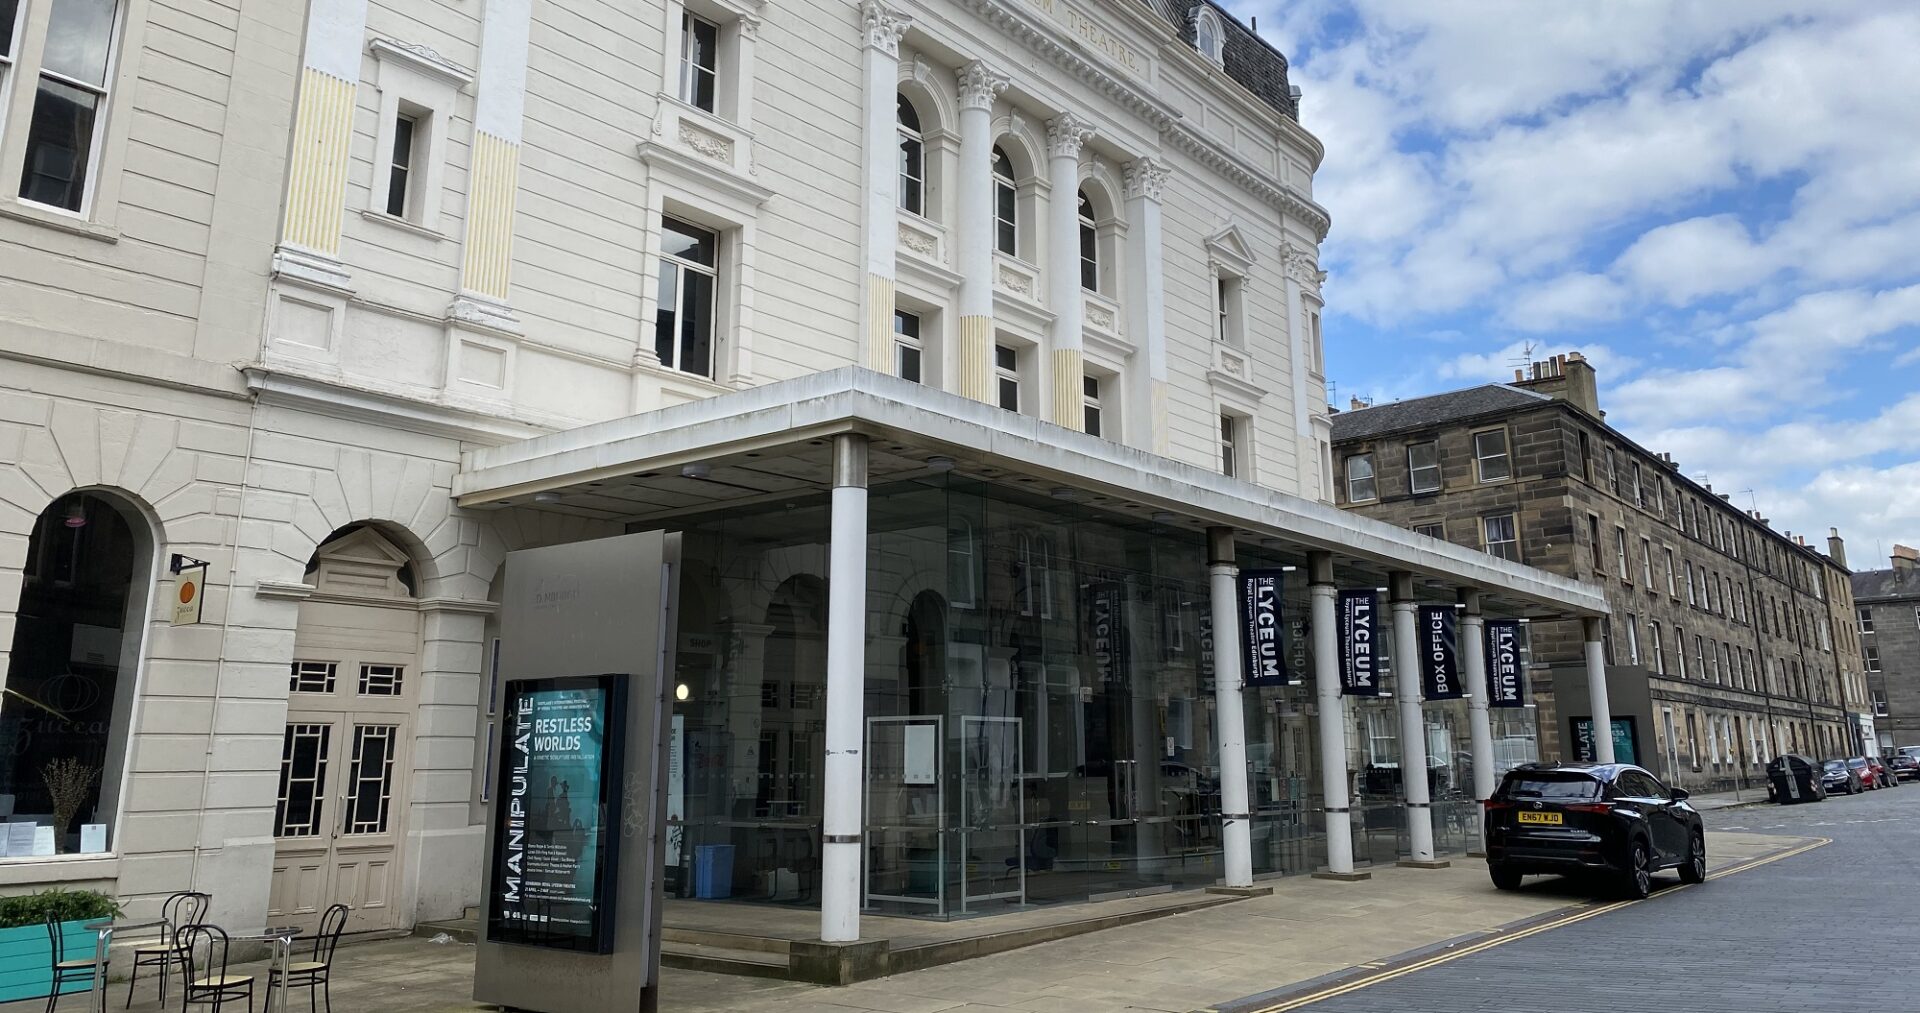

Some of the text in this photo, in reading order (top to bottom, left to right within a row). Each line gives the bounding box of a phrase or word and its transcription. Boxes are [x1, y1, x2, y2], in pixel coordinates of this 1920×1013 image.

[1067, 10, 1140, 72] THEATRE.
[1258, 577, 1275, 586] THE
[1354, 597, 1370, 605] THE
[1258, 586, 1279, 676] LYCEUM
[1354, 605, 1372, 687] LYCEUM
[1251, 645, 1260, 679] Edinburgh
[1431, 611, 1449, 693] BOX OFFICE
[1500, 633, 1517, 700] LYCEUM
[1345, 658, 1353, 688] Edinburgh
[535, 716, 592, 734] RESTLESS
[534, 735, 581, 752] WORLDS
[504, 697, 534, 903] MANIPULATE
[1522, 813, 1541, 821] EN67
